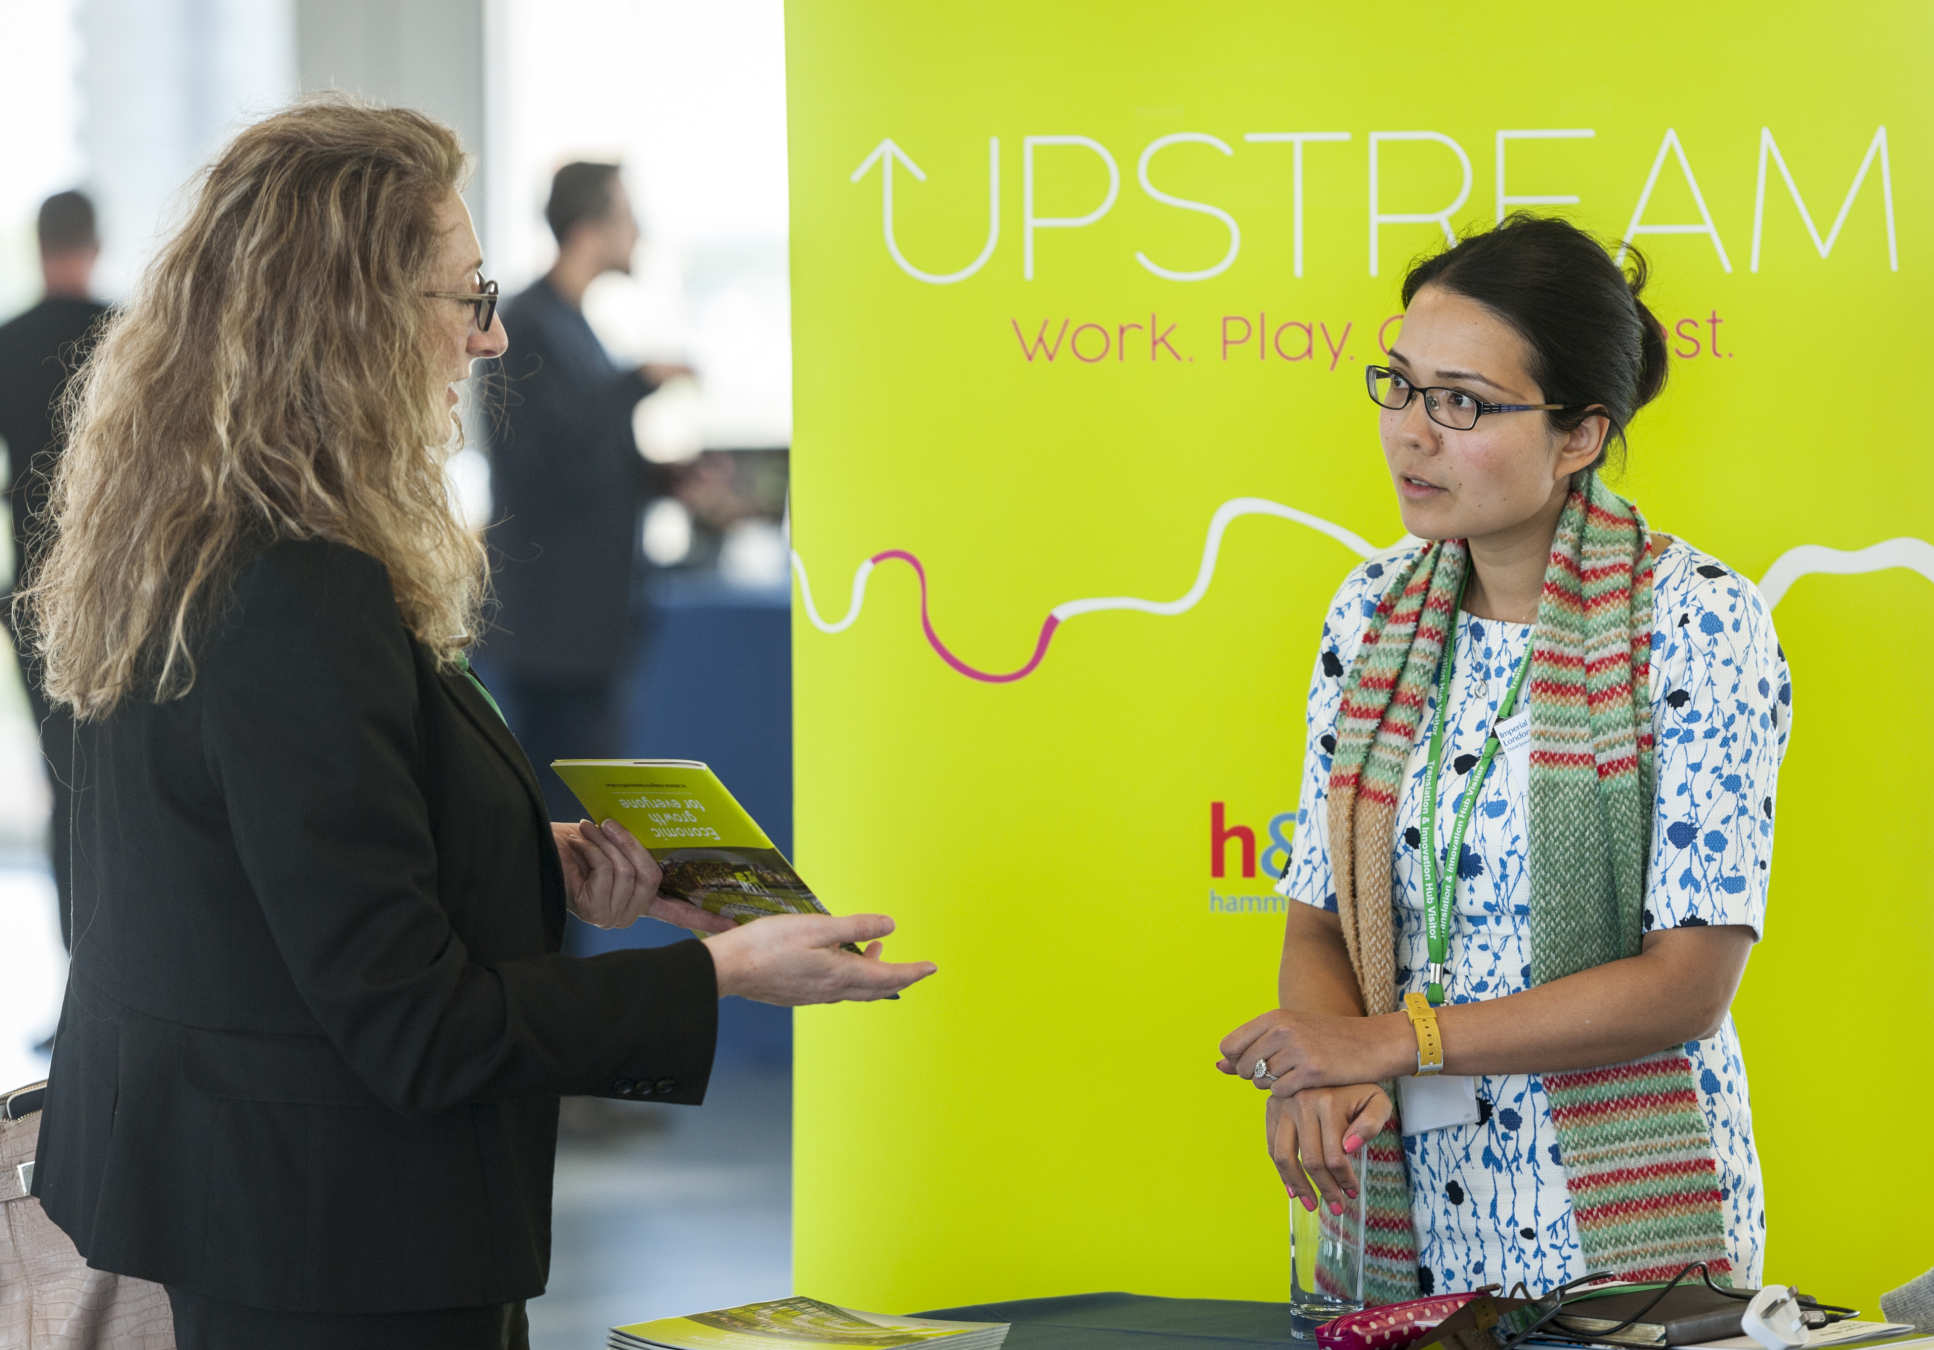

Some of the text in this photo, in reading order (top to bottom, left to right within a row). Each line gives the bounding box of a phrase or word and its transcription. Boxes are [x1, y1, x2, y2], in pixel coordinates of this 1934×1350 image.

[850, 125, 1898, 284] UPSTREAM
[1011, 312, 1194, 363] Work.
[1221, 311, 1355, 372] Play.
[1423, 762, 1435, 815] Translation
[1447, 820, 1464, 873] Innovation
[1458, 797, 1471, 819] Hub
[1466, 765, 1485, 796] Visitor
[1421, 826, 1432, 881] Innovation
[1425, 882, 1434, 904] Hub
[1427, 906, 1437, 940] Visitor
